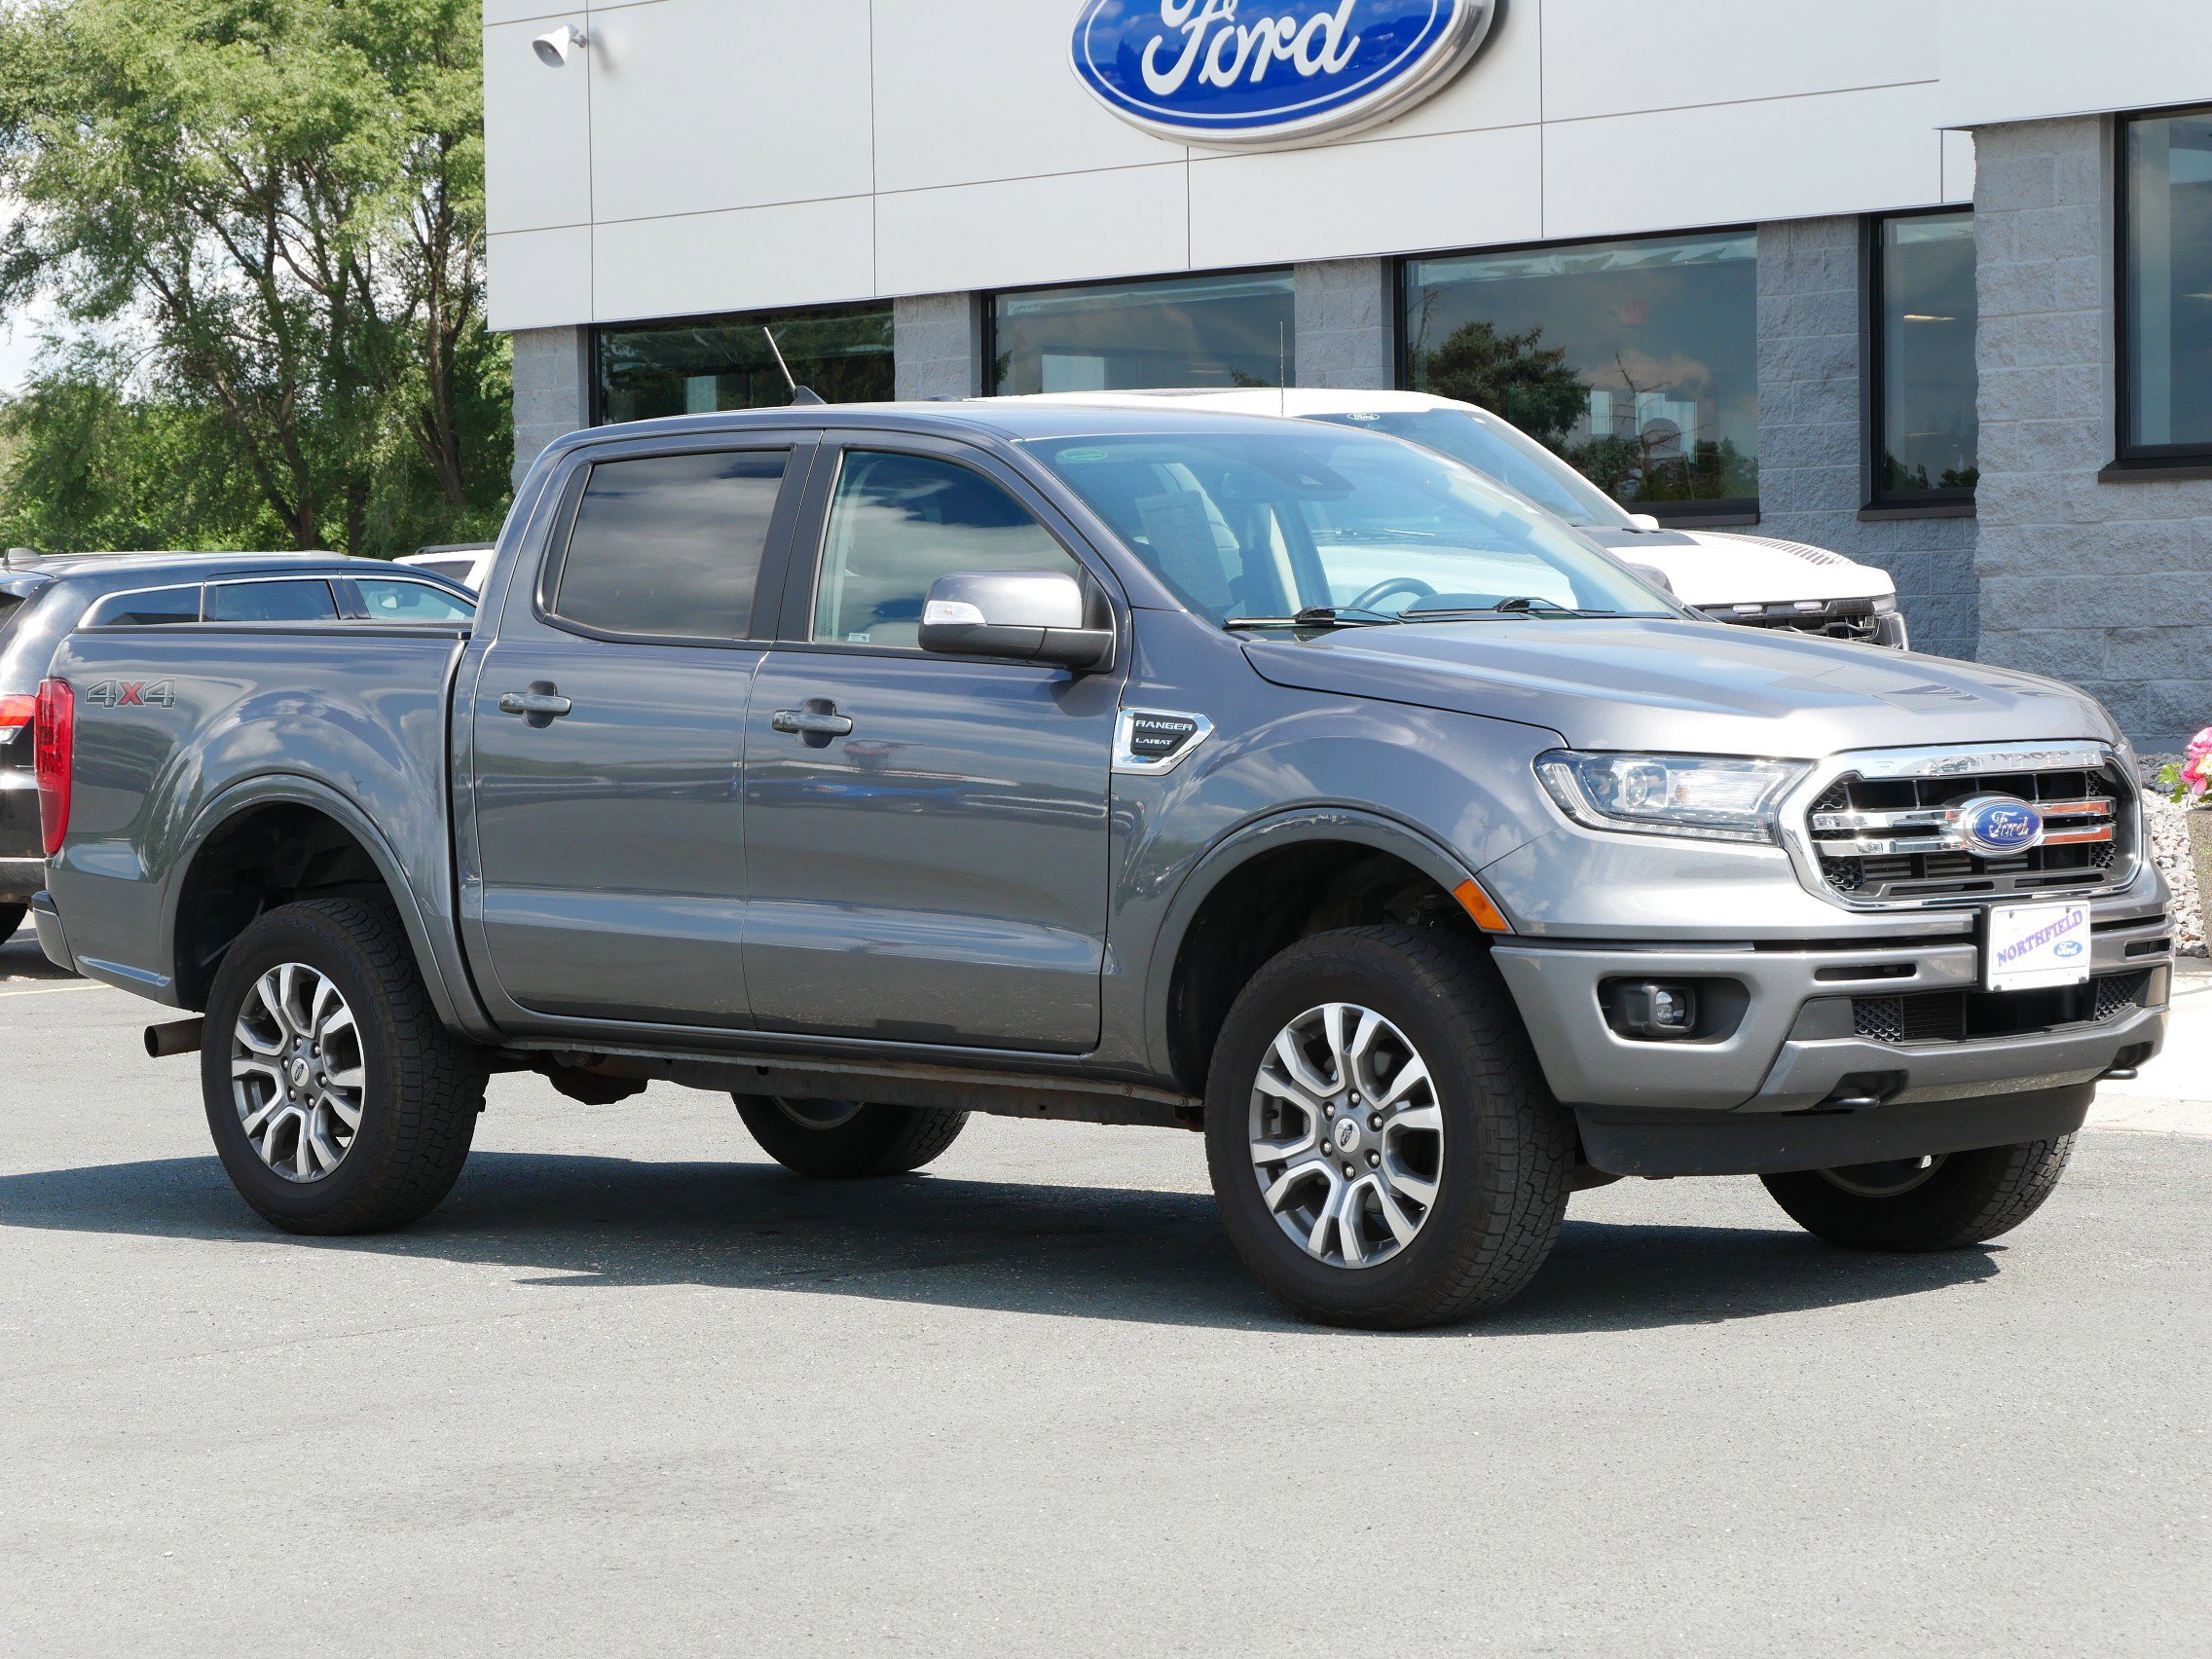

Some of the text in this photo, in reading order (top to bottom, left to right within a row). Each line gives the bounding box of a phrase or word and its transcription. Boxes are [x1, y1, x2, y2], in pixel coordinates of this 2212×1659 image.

[1141, 0, 1360, 95] Ford
[1135, 719, 1193, 731] RANGER
[1989, 811, 2029, 838] Ford
[1997, 910, 2083, 967] NORTHFIELD
